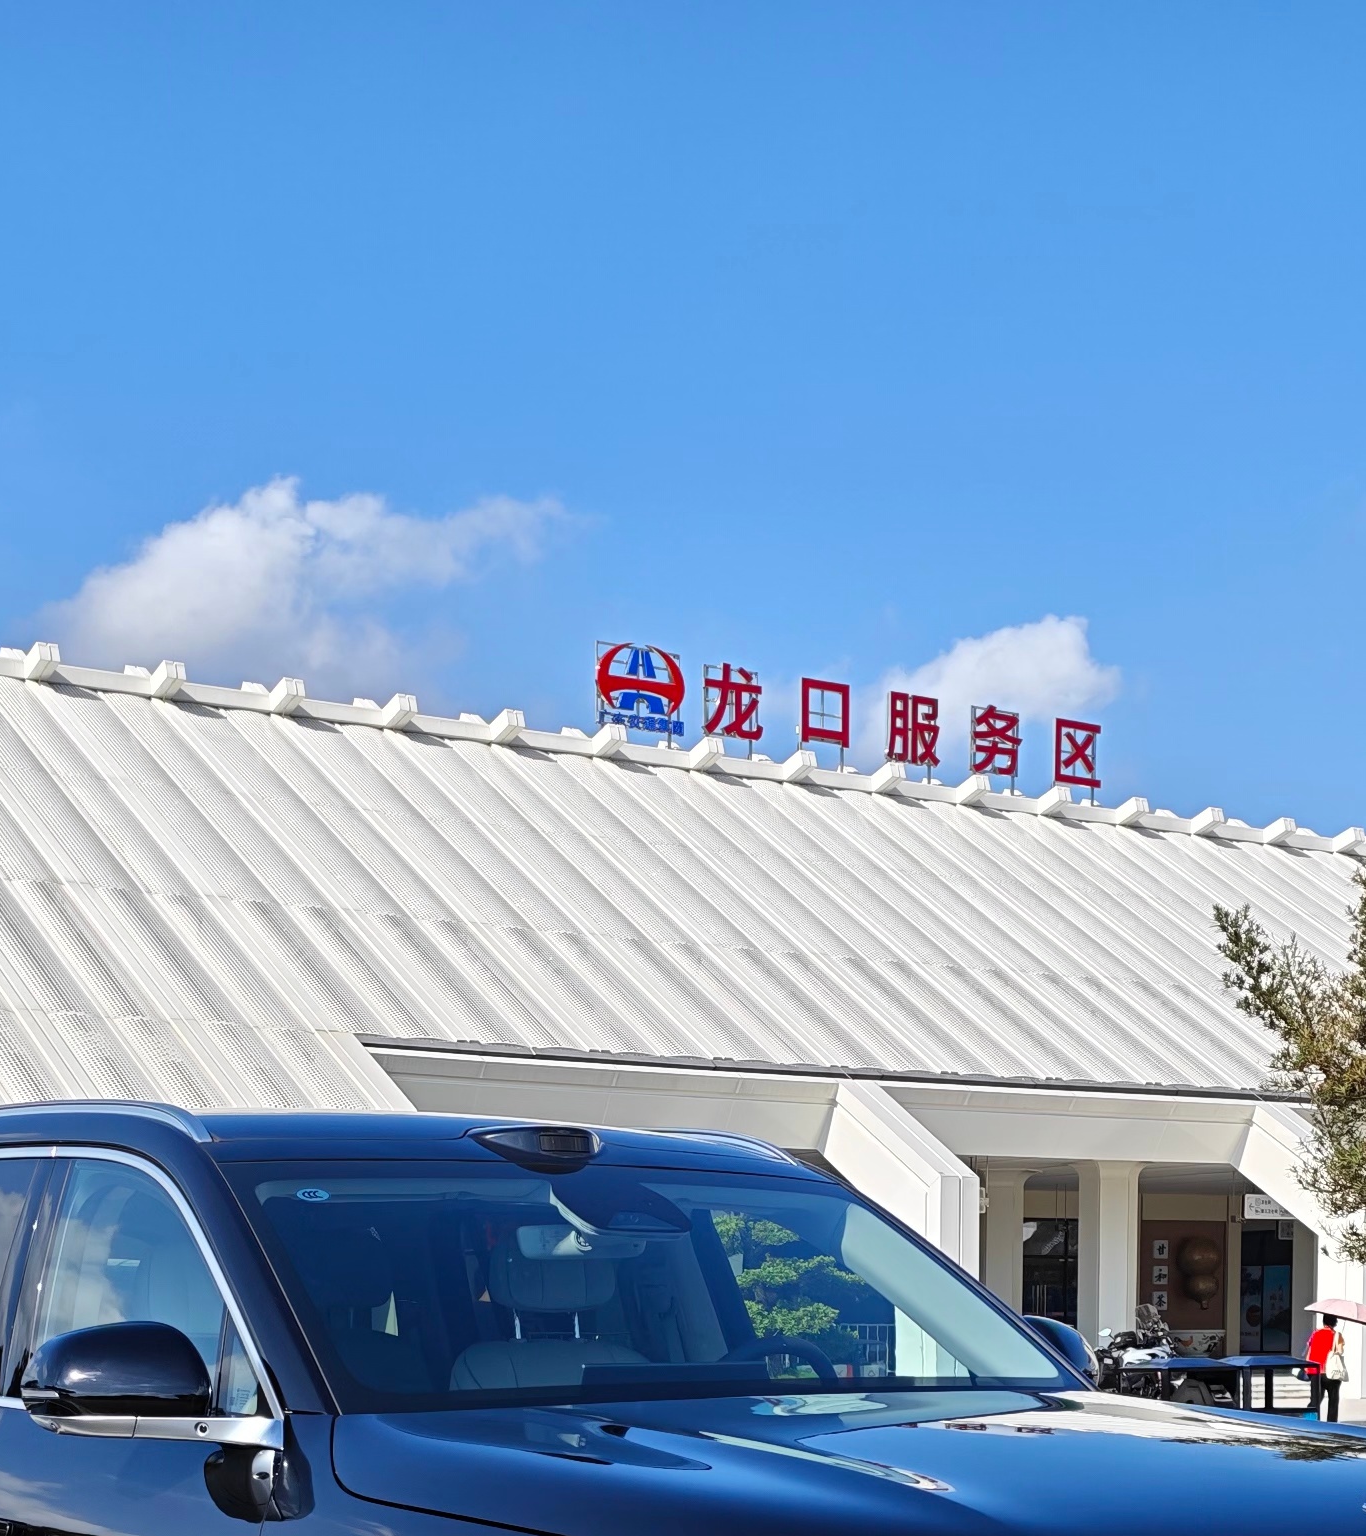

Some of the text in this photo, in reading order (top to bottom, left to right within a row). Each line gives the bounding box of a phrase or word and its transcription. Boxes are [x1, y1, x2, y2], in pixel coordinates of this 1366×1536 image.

[704, 662, 1102, 788] 龙口服务区
[1154, 1243, 1167, 1308] 甘和茶
